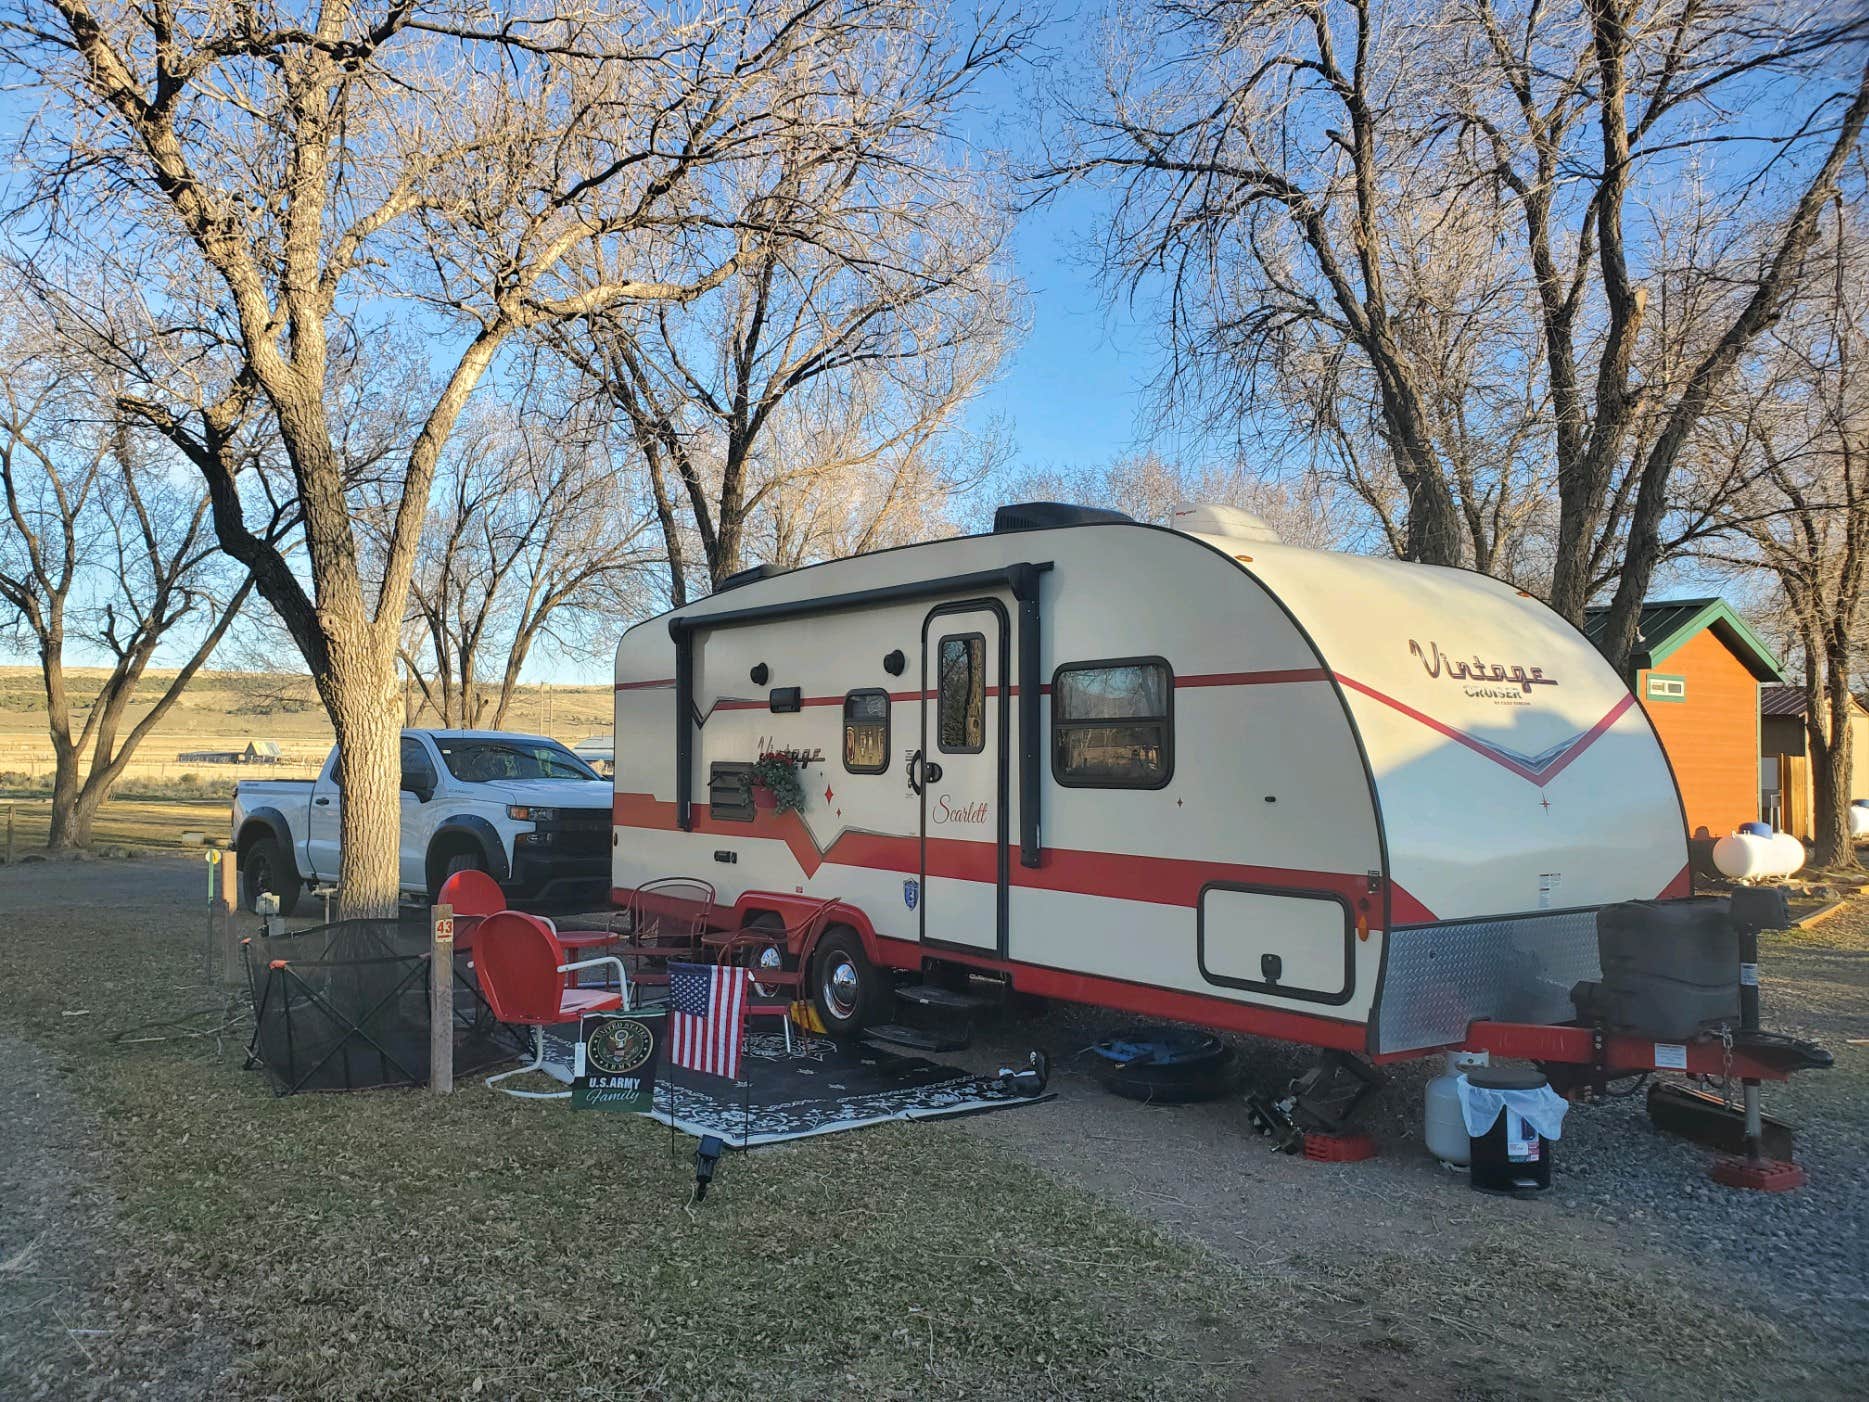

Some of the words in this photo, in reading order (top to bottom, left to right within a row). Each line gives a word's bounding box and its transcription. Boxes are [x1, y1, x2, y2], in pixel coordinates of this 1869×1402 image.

[1408, 639, 1559, 694] Vintage
[1463, 685, 1522, 699] CRUISER
[757, 735, 825, 769] Vtage
[932, 794, 988, 824] Scarlett
[437, 921, 452, 934] 43
[586, 1089, 639, 1104] Family
